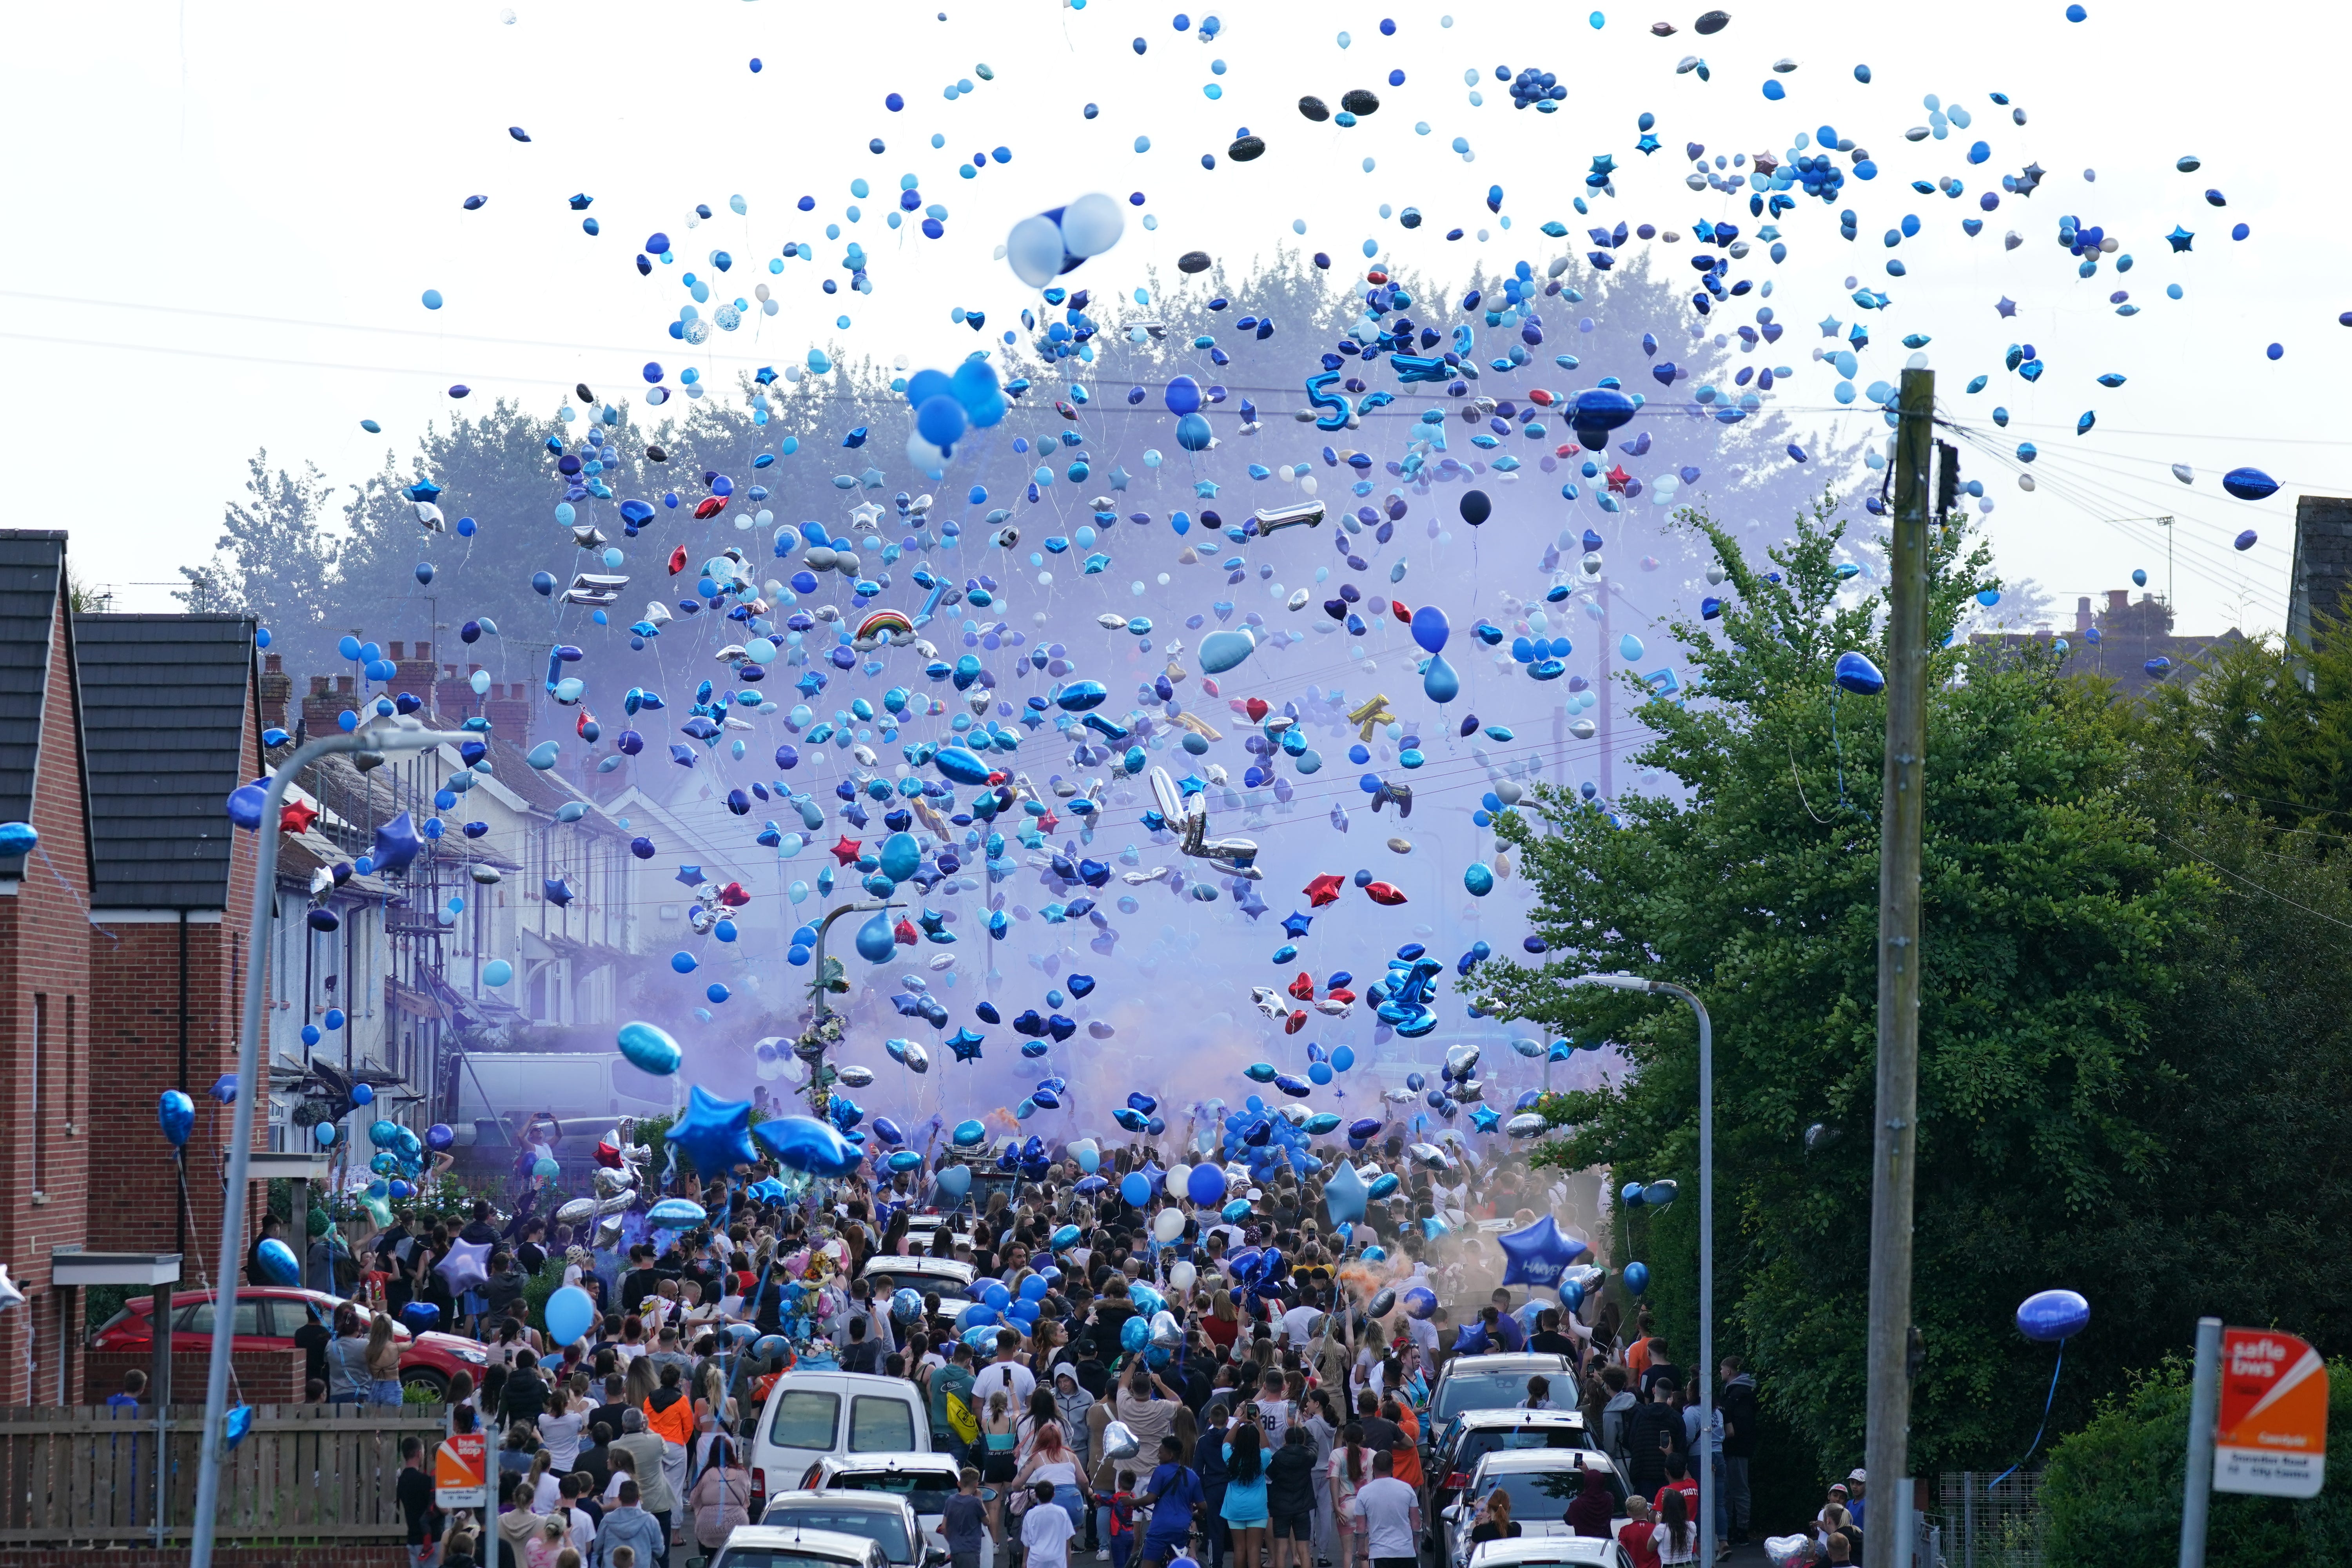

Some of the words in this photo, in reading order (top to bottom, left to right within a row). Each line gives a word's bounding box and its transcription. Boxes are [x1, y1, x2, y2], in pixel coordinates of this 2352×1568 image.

[1306, 369, 1350, 431] 5
[1522, 1260, 1564, 1276] HARVEY
[457, 1437, 477, 1447] bus
[457, 1447, 481, 1457] stop
